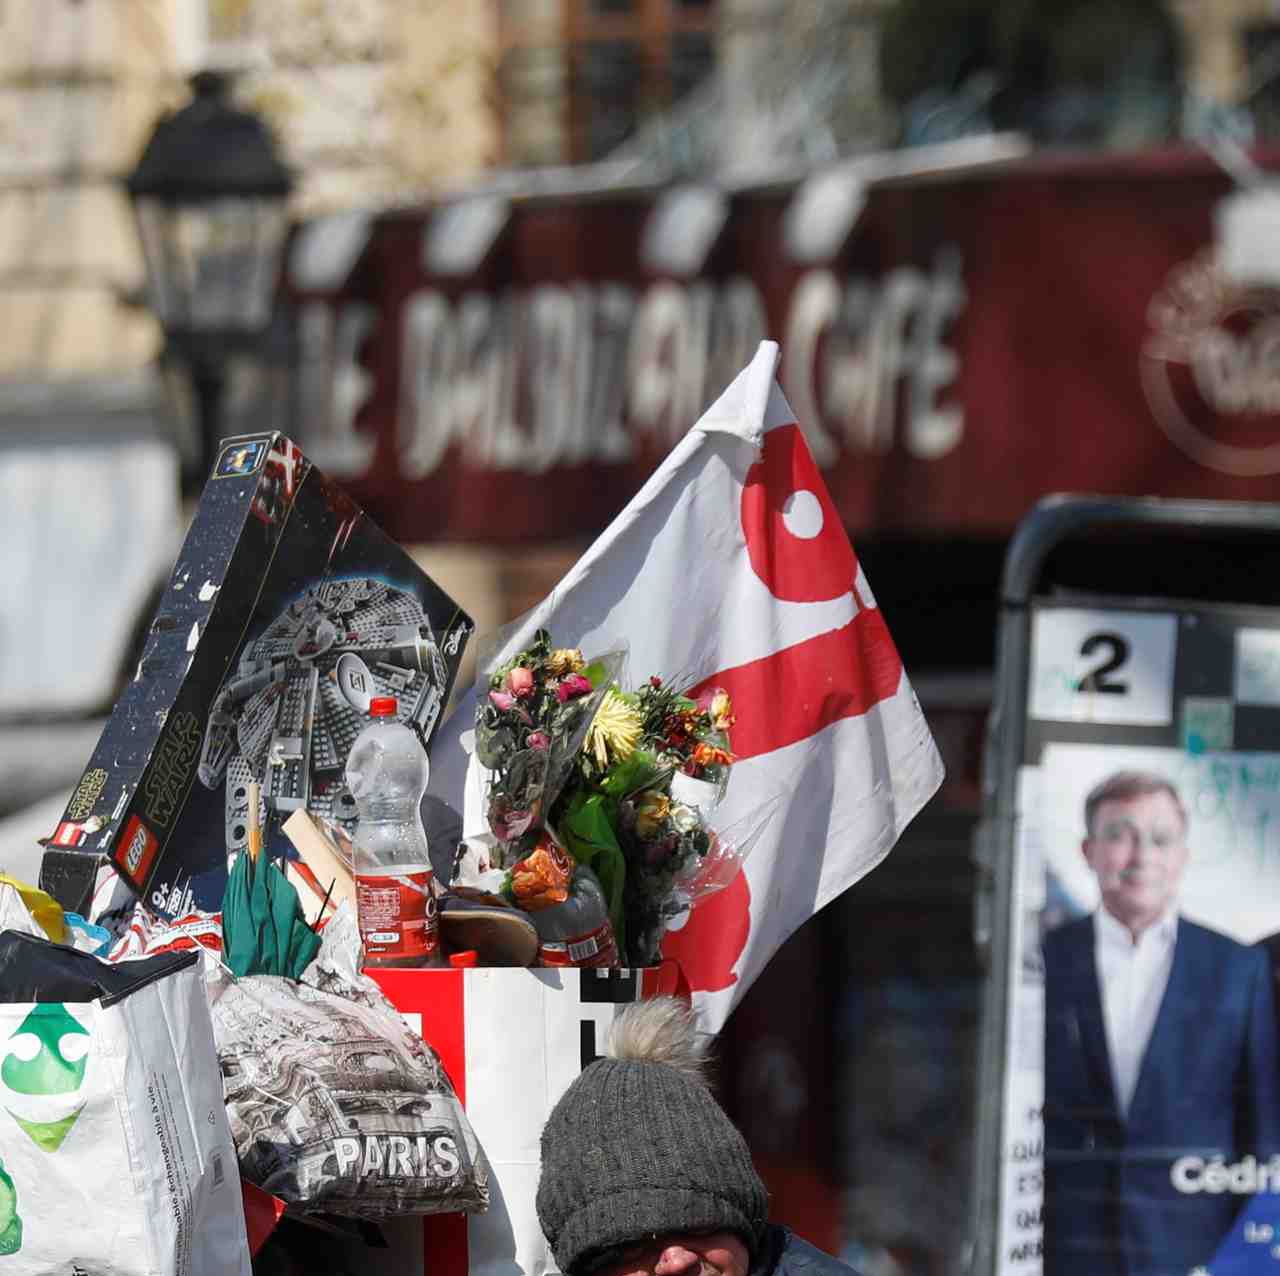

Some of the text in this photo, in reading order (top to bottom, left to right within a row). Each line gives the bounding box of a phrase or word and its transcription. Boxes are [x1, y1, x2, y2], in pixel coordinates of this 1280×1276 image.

[1078, 632, 1130, 694] 2
[127, 824, 148, 877] LEGO
[151, 881, 169, 909] 9+
[333, 1135, 460, 1178] PARIS
